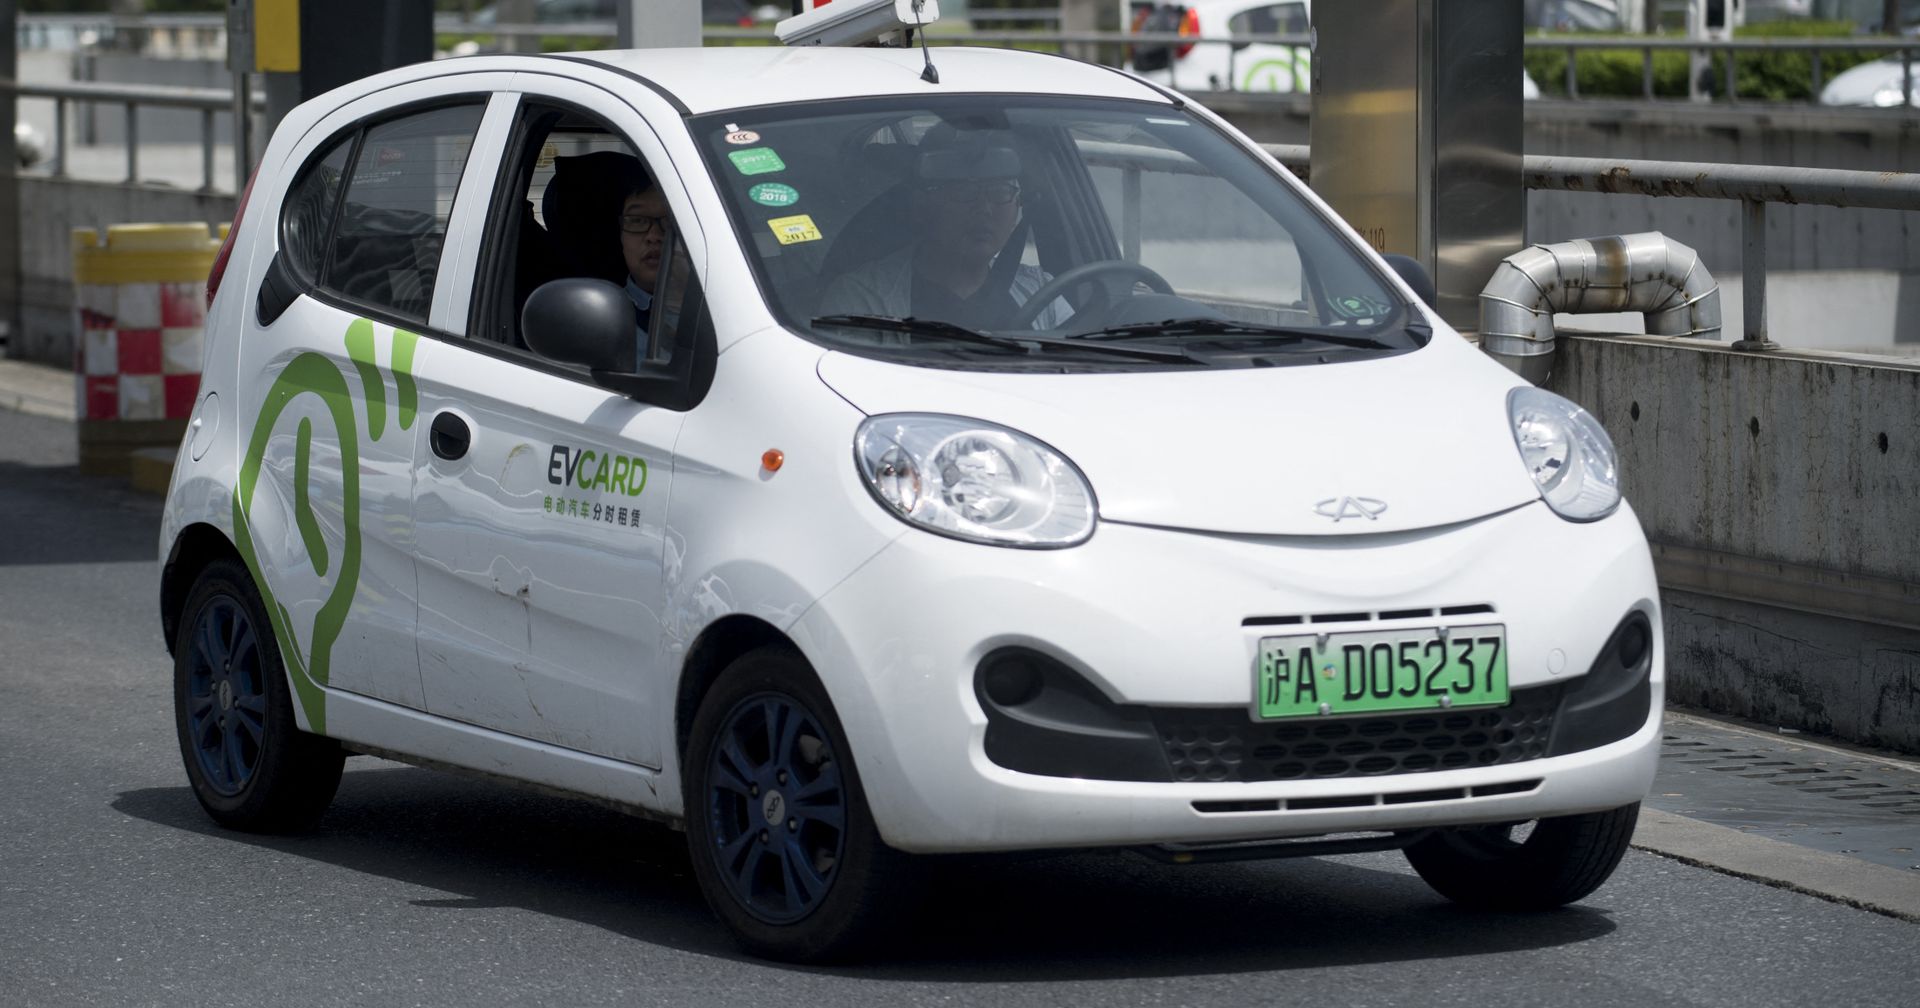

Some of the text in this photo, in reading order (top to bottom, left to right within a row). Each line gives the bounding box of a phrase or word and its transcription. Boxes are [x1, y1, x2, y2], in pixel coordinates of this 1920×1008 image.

[759, 192, 787, 202] 2018
[783, 231, 815, 242] 2017
[547, 444, 648, 497] EVCARD
[543, 495, 641, 528] 电动汽车分时租赁
